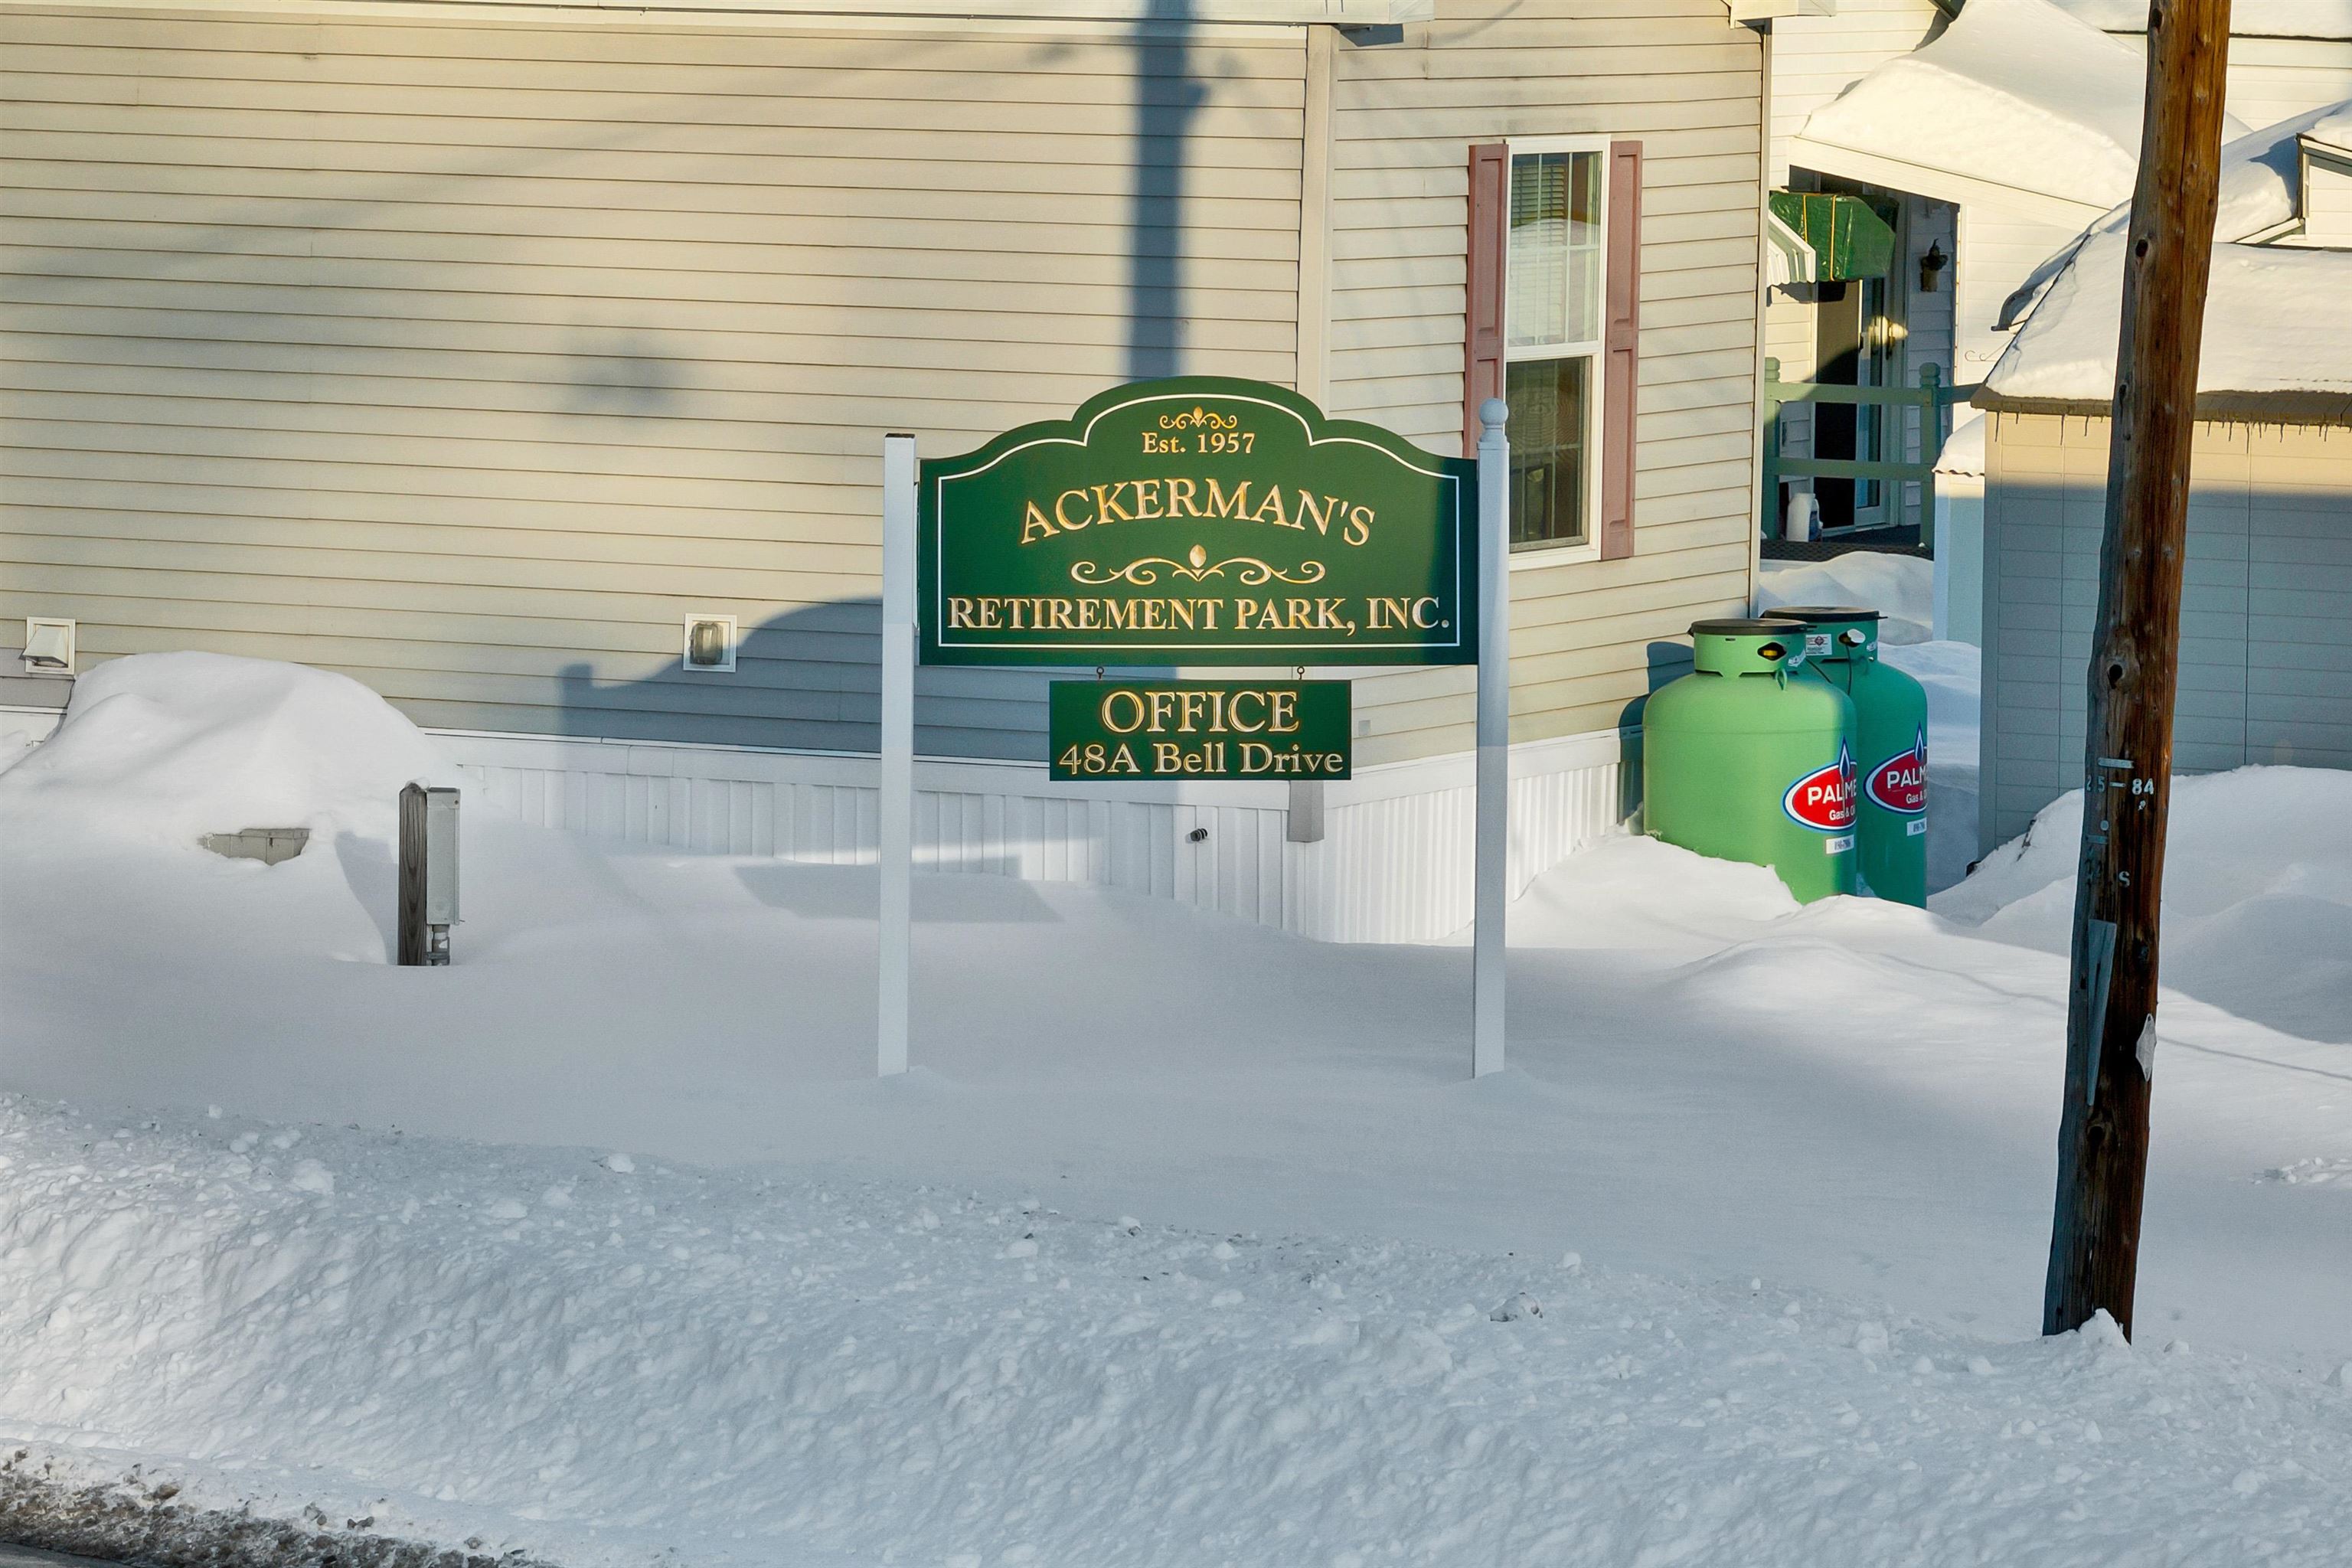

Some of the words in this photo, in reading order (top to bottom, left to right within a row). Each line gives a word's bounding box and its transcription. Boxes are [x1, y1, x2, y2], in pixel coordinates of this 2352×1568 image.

[1141, 432, 1187, 454] Est.
[1197, 431, 1256, 454] 1957
[1020, 476, 1376, 549] ACKERMAN'S
[947, 597, 1224, 631] RETIREMENT
[1233, 597, 1357, 637] PARK,
[1365, 596, 1449, 630] INC.
[1101, 691, 1300, 733] OFFICE
[1058, 743, 1141, 775] 48A
[1152, 741, 1227, 773] Bell
[1238, 743, 1344, 773] Drive
[1829, 809, 1844, 821] Gas
